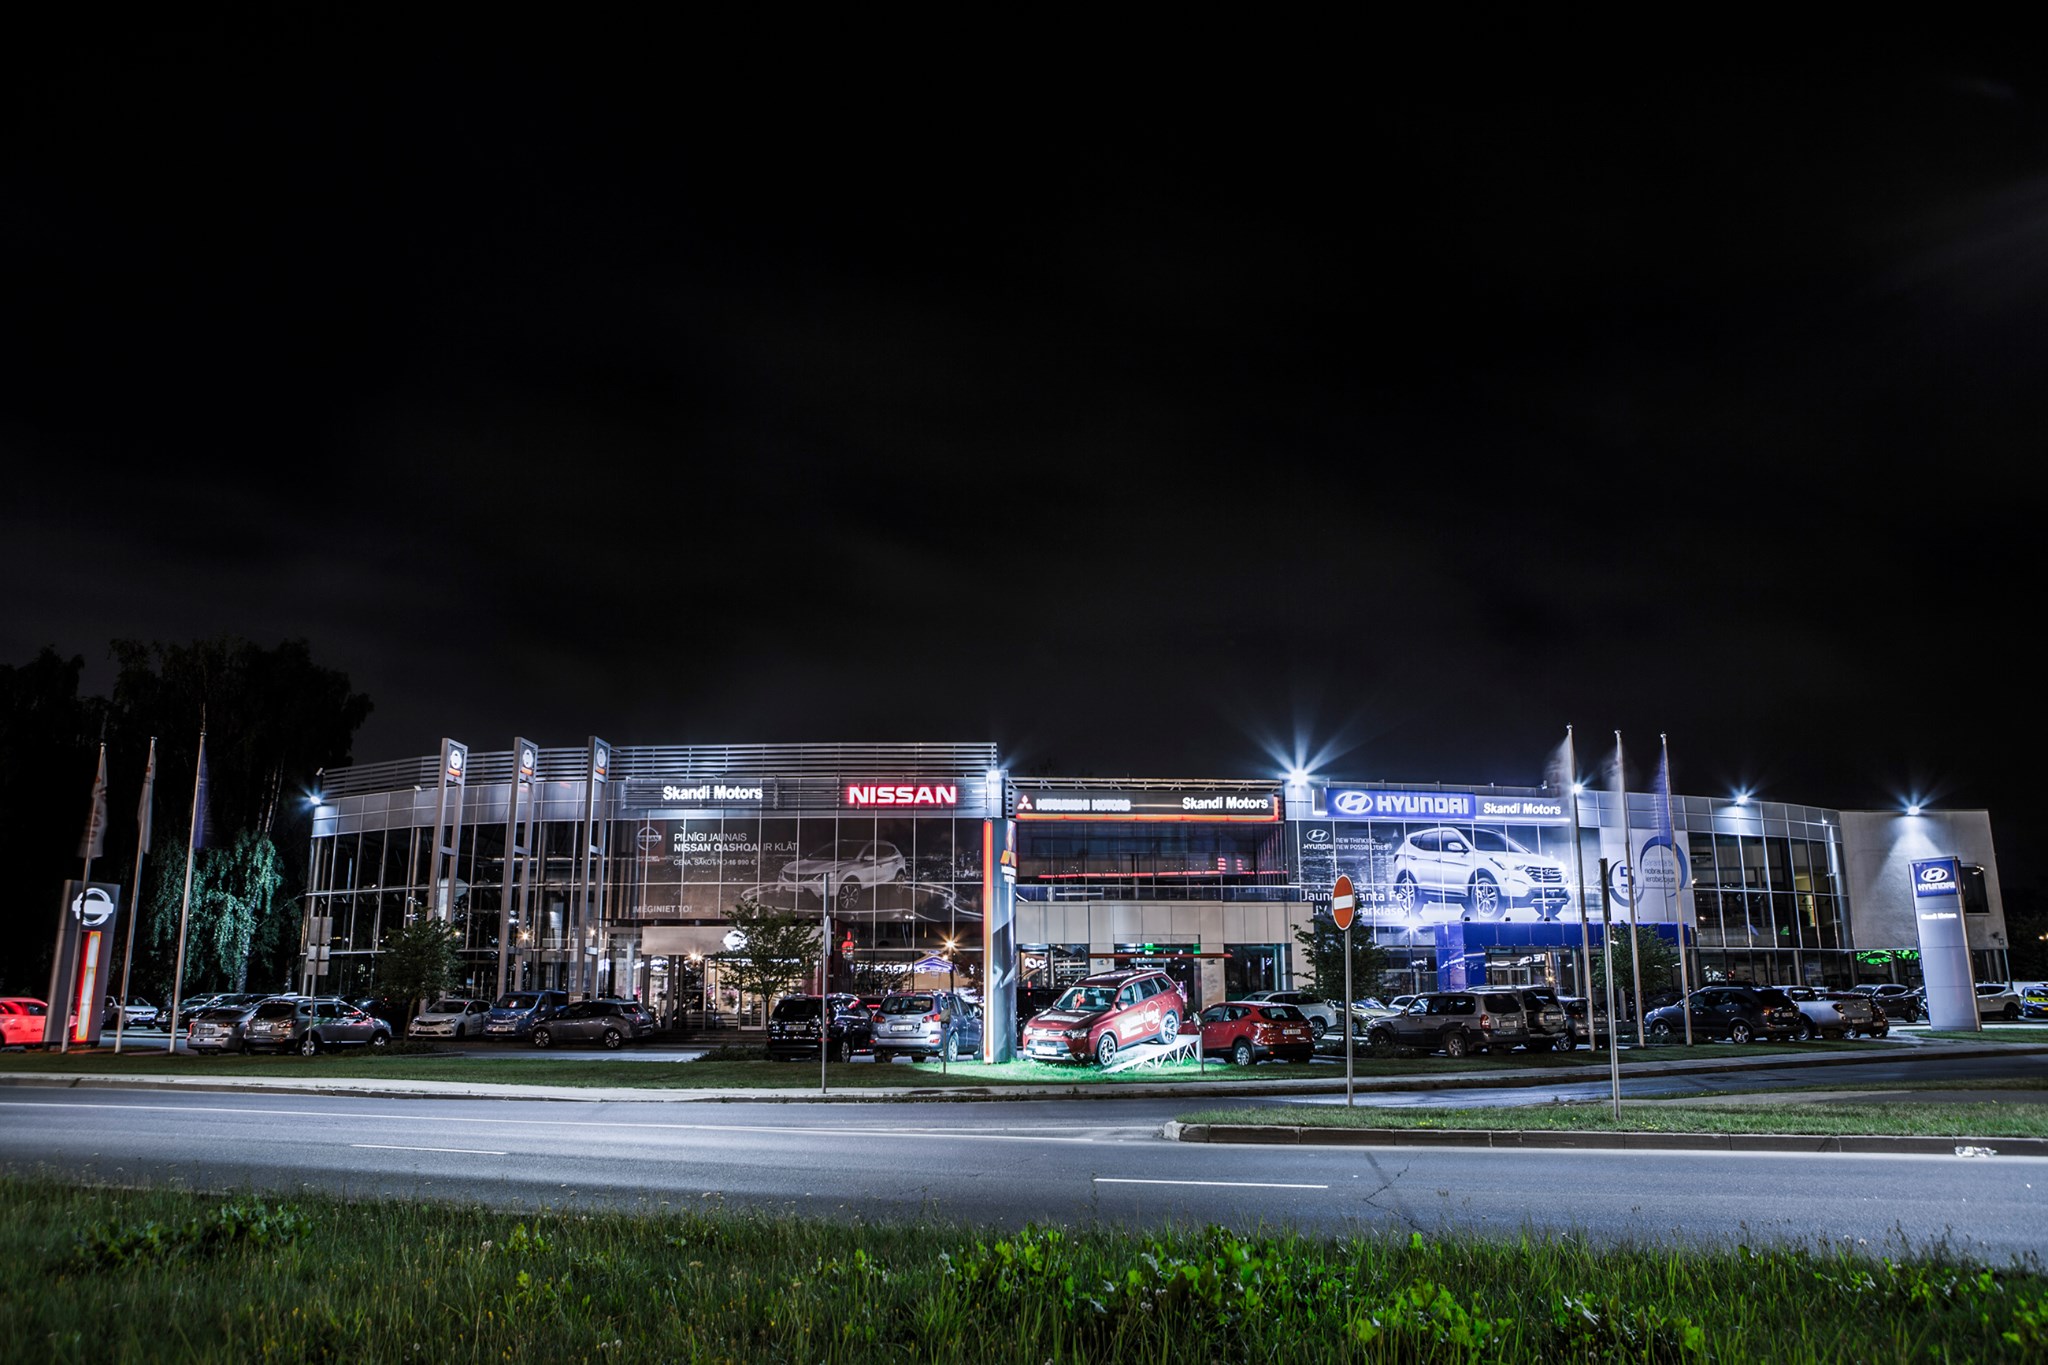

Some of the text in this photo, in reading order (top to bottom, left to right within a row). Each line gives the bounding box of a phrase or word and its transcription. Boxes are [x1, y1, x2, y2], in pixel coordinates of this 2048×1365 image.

[663, 786, 763, 800] Skandi Motors
[848, 786, 957, 804] NISSAN
[1182, 797, 1269, 810] Skandi Motors
[1377, 795, 1469, 814] HYUNDAI
[1483, 802, 1562, 815] Skandi Motors
[708, 834, 747, 842] JAUNAIS
[674, 843, 711, 852] NISSAN
[713, 843, 760, 852] QASHQA
[763, 843, 772, 852] IR
[1303, 843, 1334, 851] HYUNDAI
[1355, 890, 1385, 902] anta
